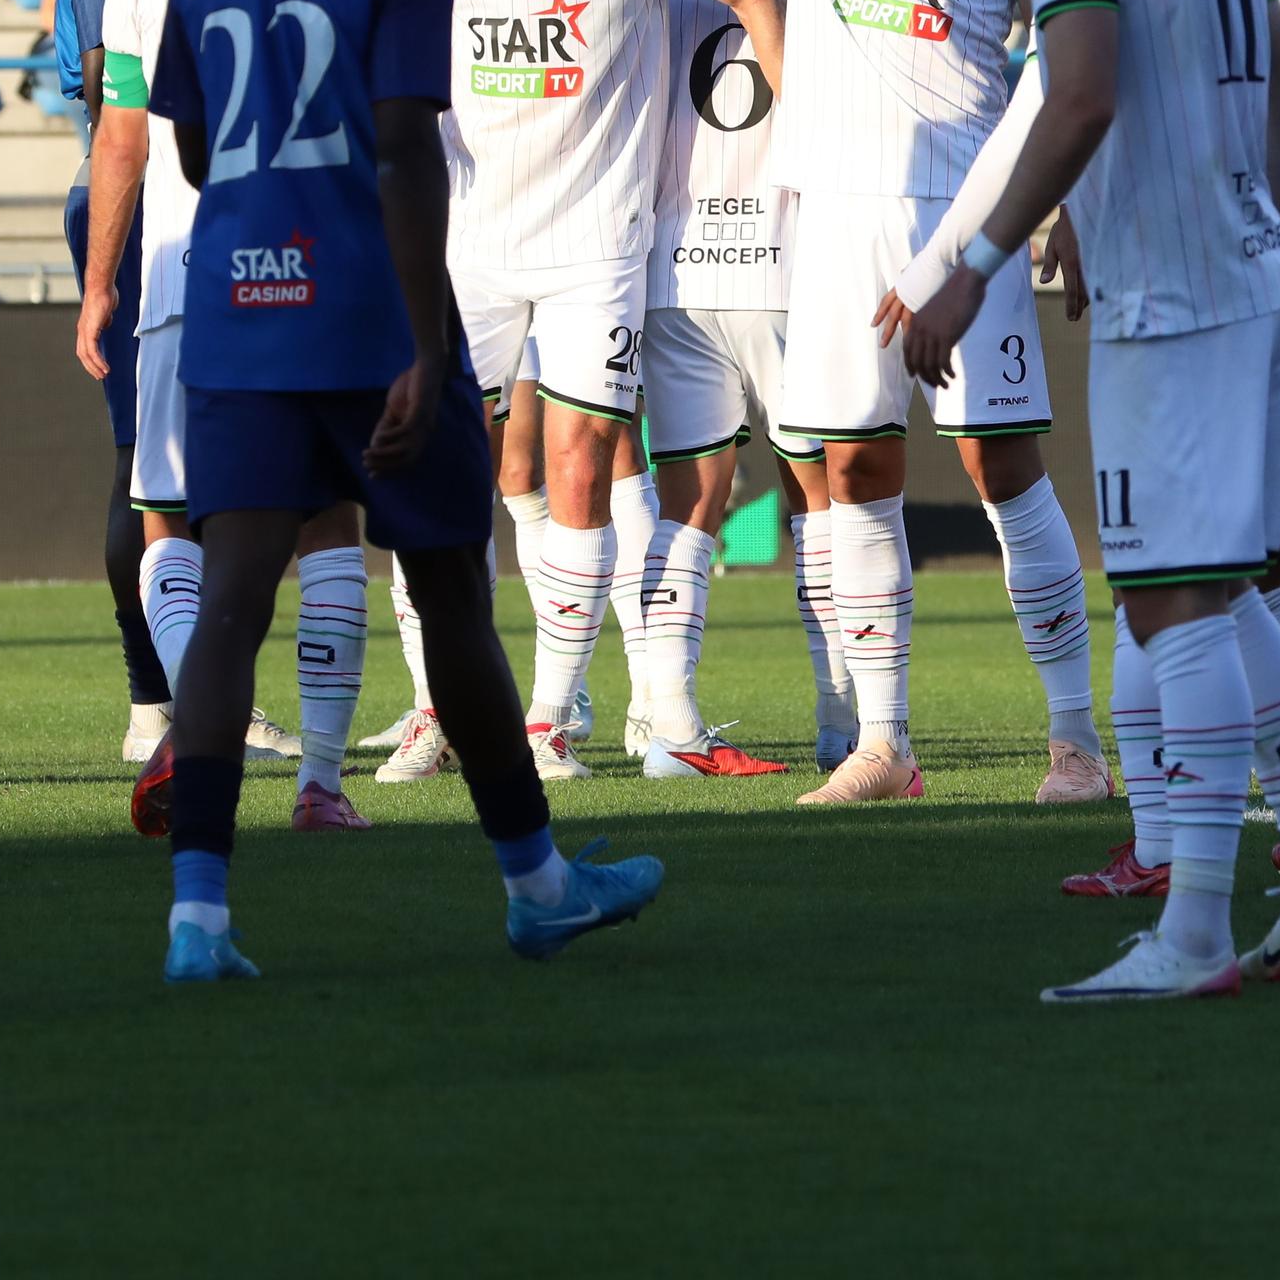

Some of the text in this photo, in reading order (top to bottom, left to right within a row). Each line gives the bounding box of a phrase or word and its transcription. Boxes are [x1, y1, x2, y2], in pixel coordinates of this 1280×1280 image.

[917, 12, 947, 34] TV
[468, 17, 576, 64] STAR
[200, 0, 350, 185] 22
[474, 70, 578, 94] SPORT TV
[689, 23, 774, 132] 6
[697, 198, 765, 215] TEGEL
[230, 247, 309, 281] STAR
[673, 247, 781, 264] CONCEPT
[237, 284, 308, 303] CASINO
[605, 326, 644, 376] 28
[999, 334, 1027, 385] 3
[988, 396, 1029, 406] STANNO
[1098, 468, 1138, 528] 11
